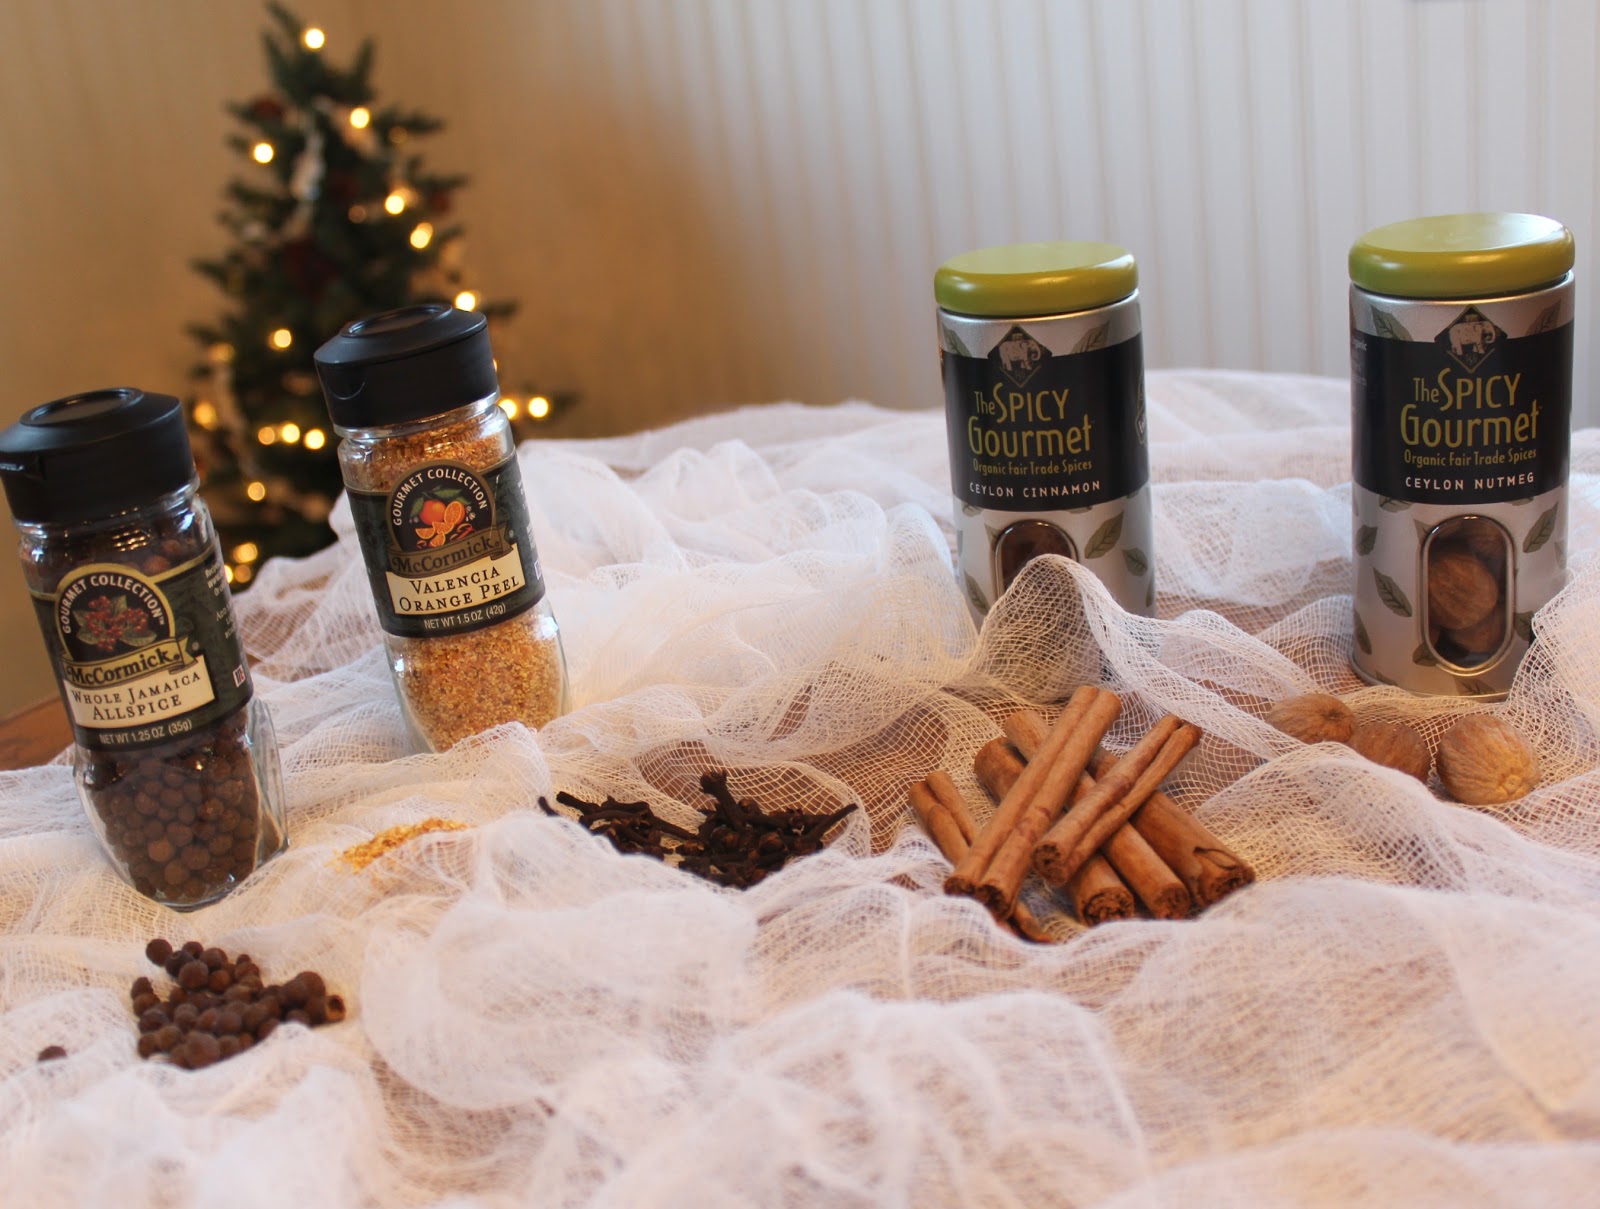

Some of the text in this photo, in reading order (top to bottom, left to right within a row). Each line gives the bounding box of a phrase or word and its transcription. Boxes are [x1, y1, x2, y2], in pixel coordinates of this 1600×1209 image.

[974, 382, 1069, 423] The SPICY
[1413, 367, 1522, 411] The SPICY
[968, 413, 1092, 458] Gourmet
[1400, 399, 1539, 448] Gourmet
[973, 459, 1092, 476] Organic Fair Trade Spices
[1404, 448, 1536, 468] Organic Fair Trade Spices
[392, 473, 423, 526] GOURMET
[427, 468, 487, 510] COLLECTION
[969, 481, 1100, 498] CEYLON CINNAMON
[1405, 472, 1534, 490] CEYLON NUTMEG
[392, 538, 495, 574] McCormick
[399, 576, 519, 611] ORANGE PEEL
[409, 566, 500, 595] VALENCIA
[61, 579, 87, 634] GOURMET
[424, 603, 506, 629] NET WT 1.5 OZ (42g)
[67, 648, 172, 685] McCormick
[72, 671, 201, 704] WHOLE JAMAICA
[93, 694, 182, 721] ALLSPICE
[100, 719, 192, 744] NET WT 1.25 OZ (35g)
